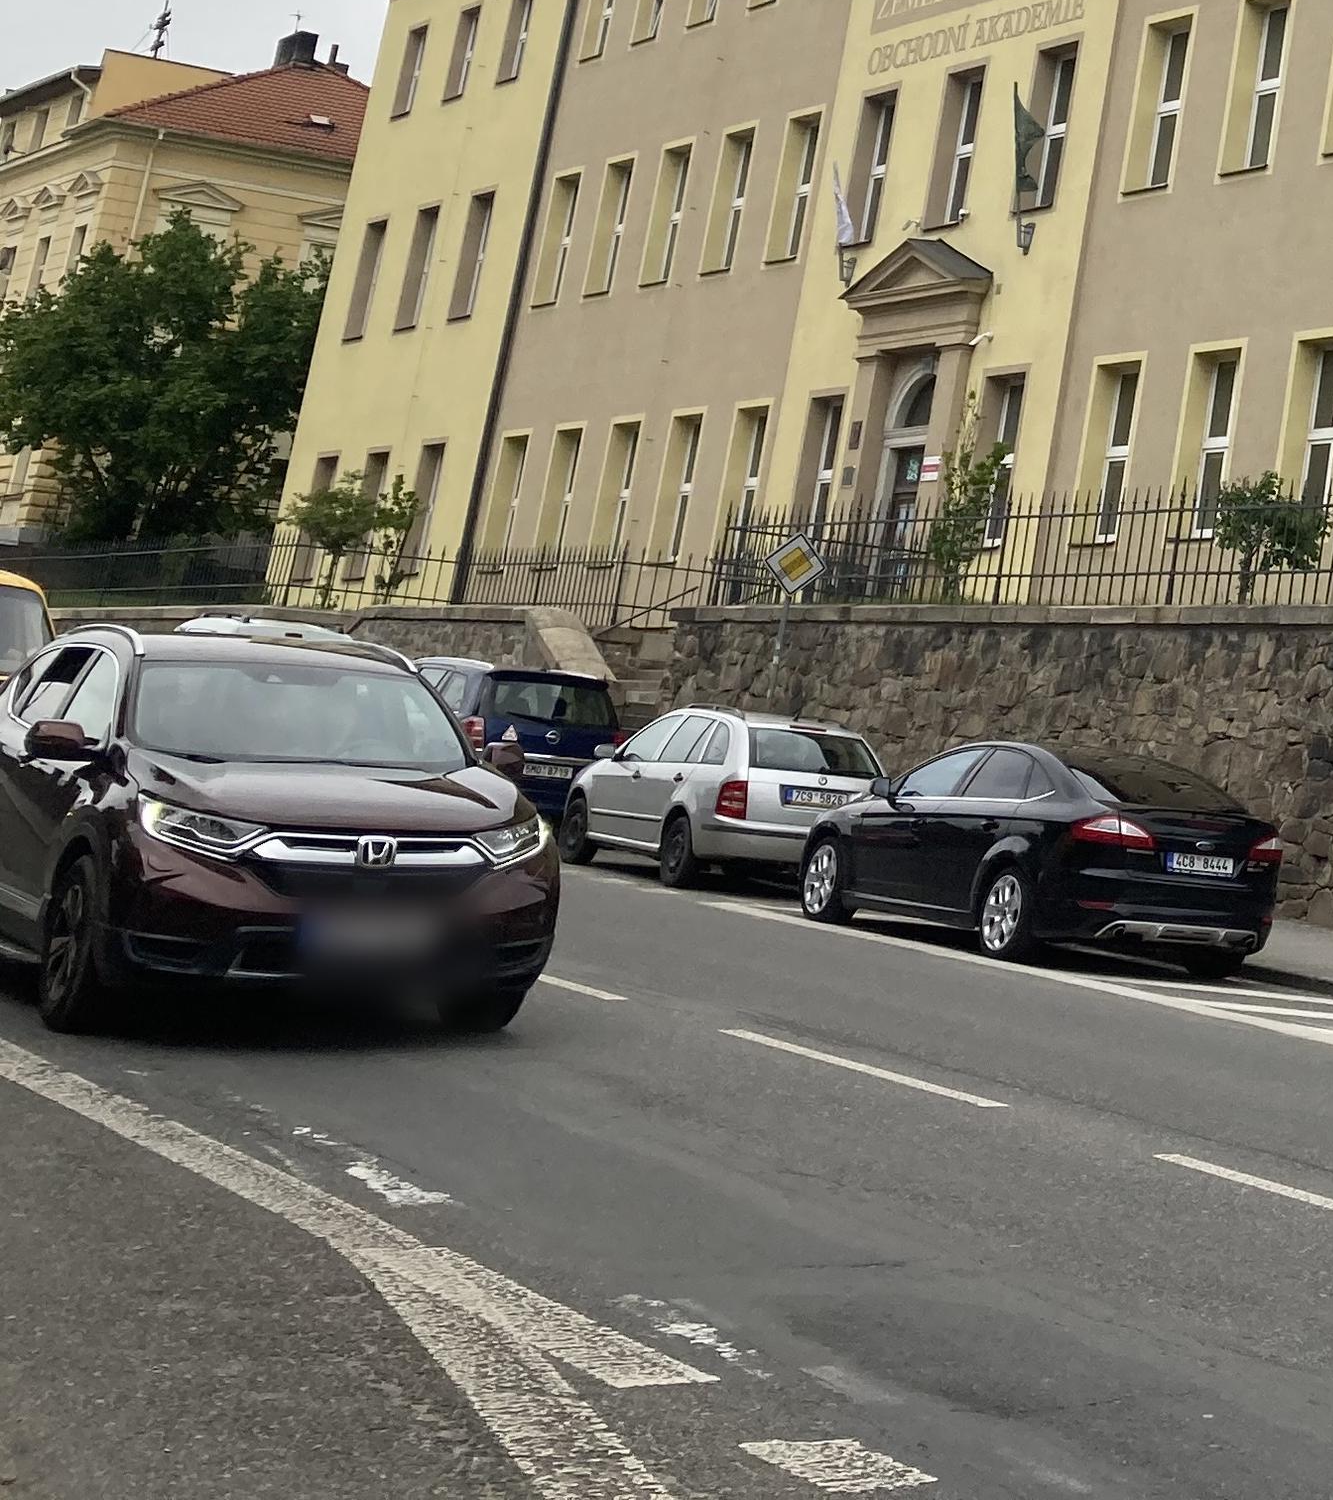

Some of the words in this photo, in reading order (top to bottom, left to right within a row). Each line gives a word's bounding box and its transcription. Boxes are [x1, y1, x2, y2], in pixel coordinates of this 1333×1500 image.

[867, 14, 972, 76] OBCHODNÍ
[795, 790, 813, 802] 7C9
[820, 793, 843, 805] 5826
[1176, 854, 1195, 868] 4C8
[1202, 857, 1228, 871] 8444
